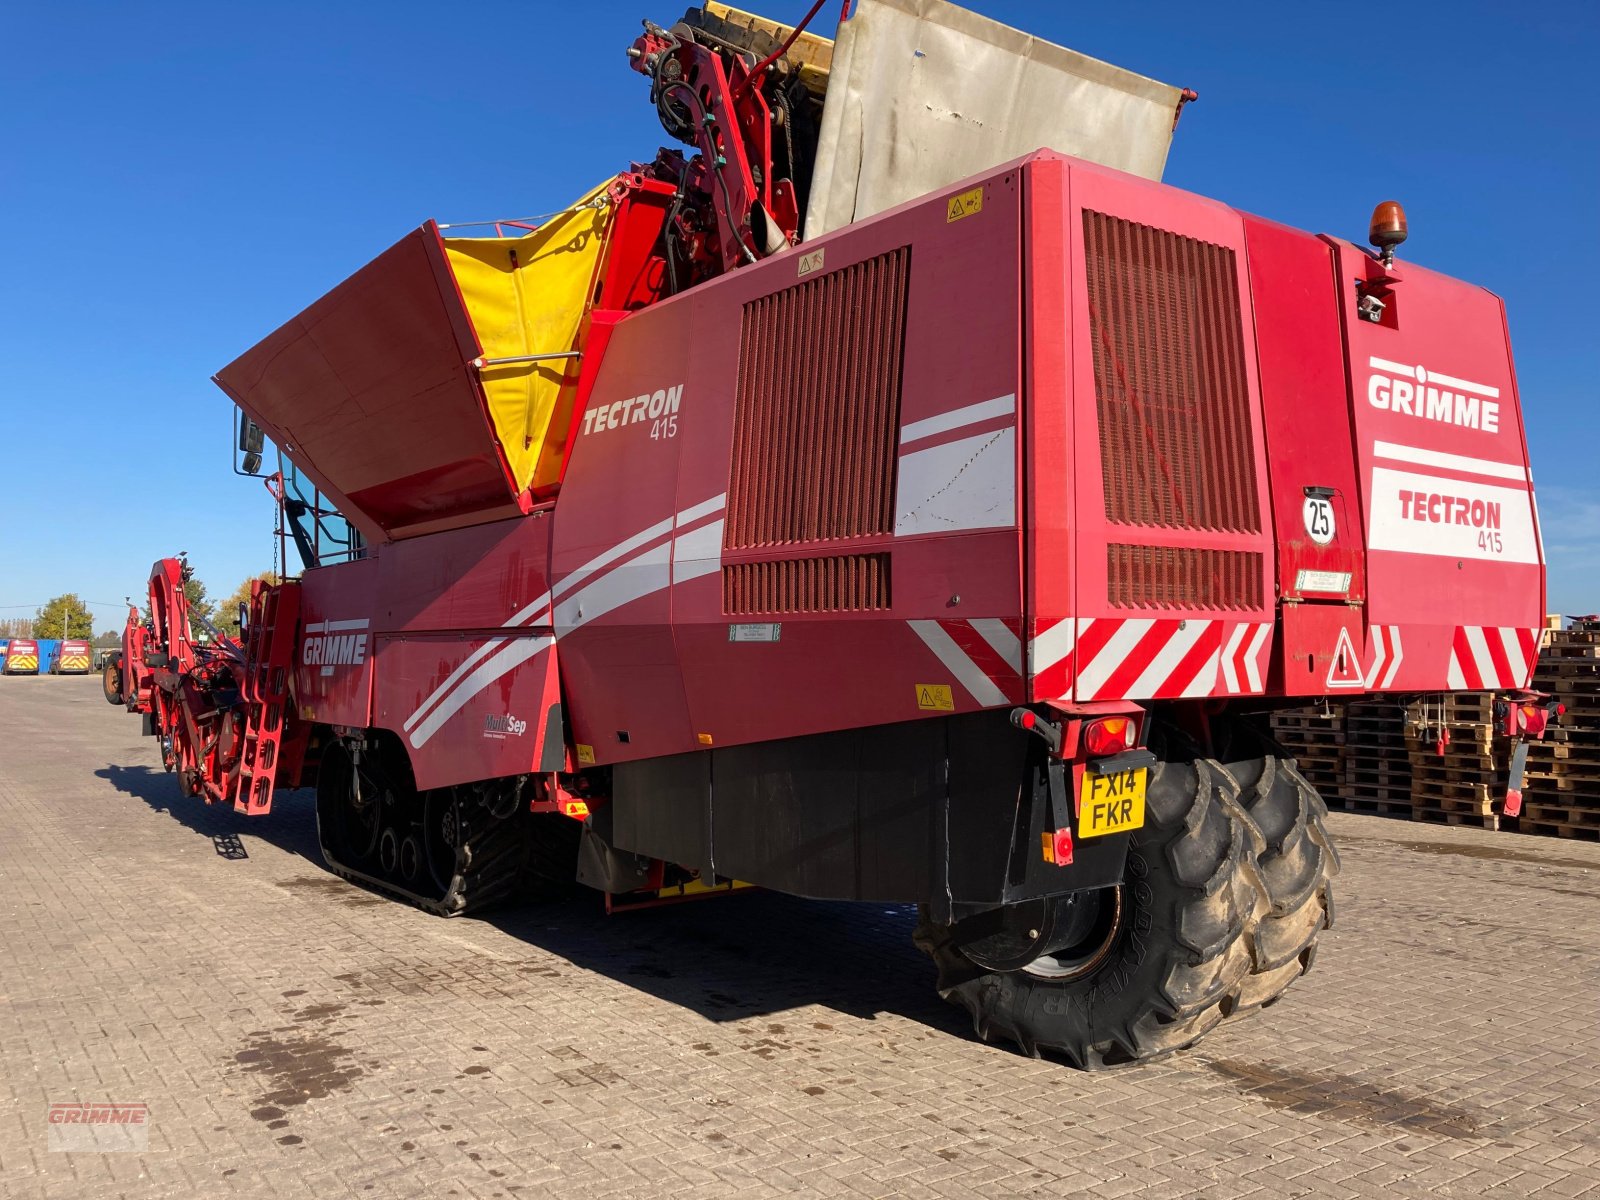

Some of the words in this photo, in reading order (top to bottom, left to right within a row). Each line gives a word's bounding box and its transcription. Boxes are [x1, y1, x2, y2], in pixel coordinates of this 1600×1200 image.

[583, 384, 684, 436] TECTRON
[1368, 364, 1500, 434] GRIMME
[650, 414, 678, 440] 415
[1309, 501, 1329, 536] 25
[1398, 489, 1501, 530] TECTRON
[1478, 530, 1503, 553] 415
[303, 618, 368, 665] GRIMME
[1091, 769, 1136, 800] FX14
[1092, 798, 1133, 829] FKR
